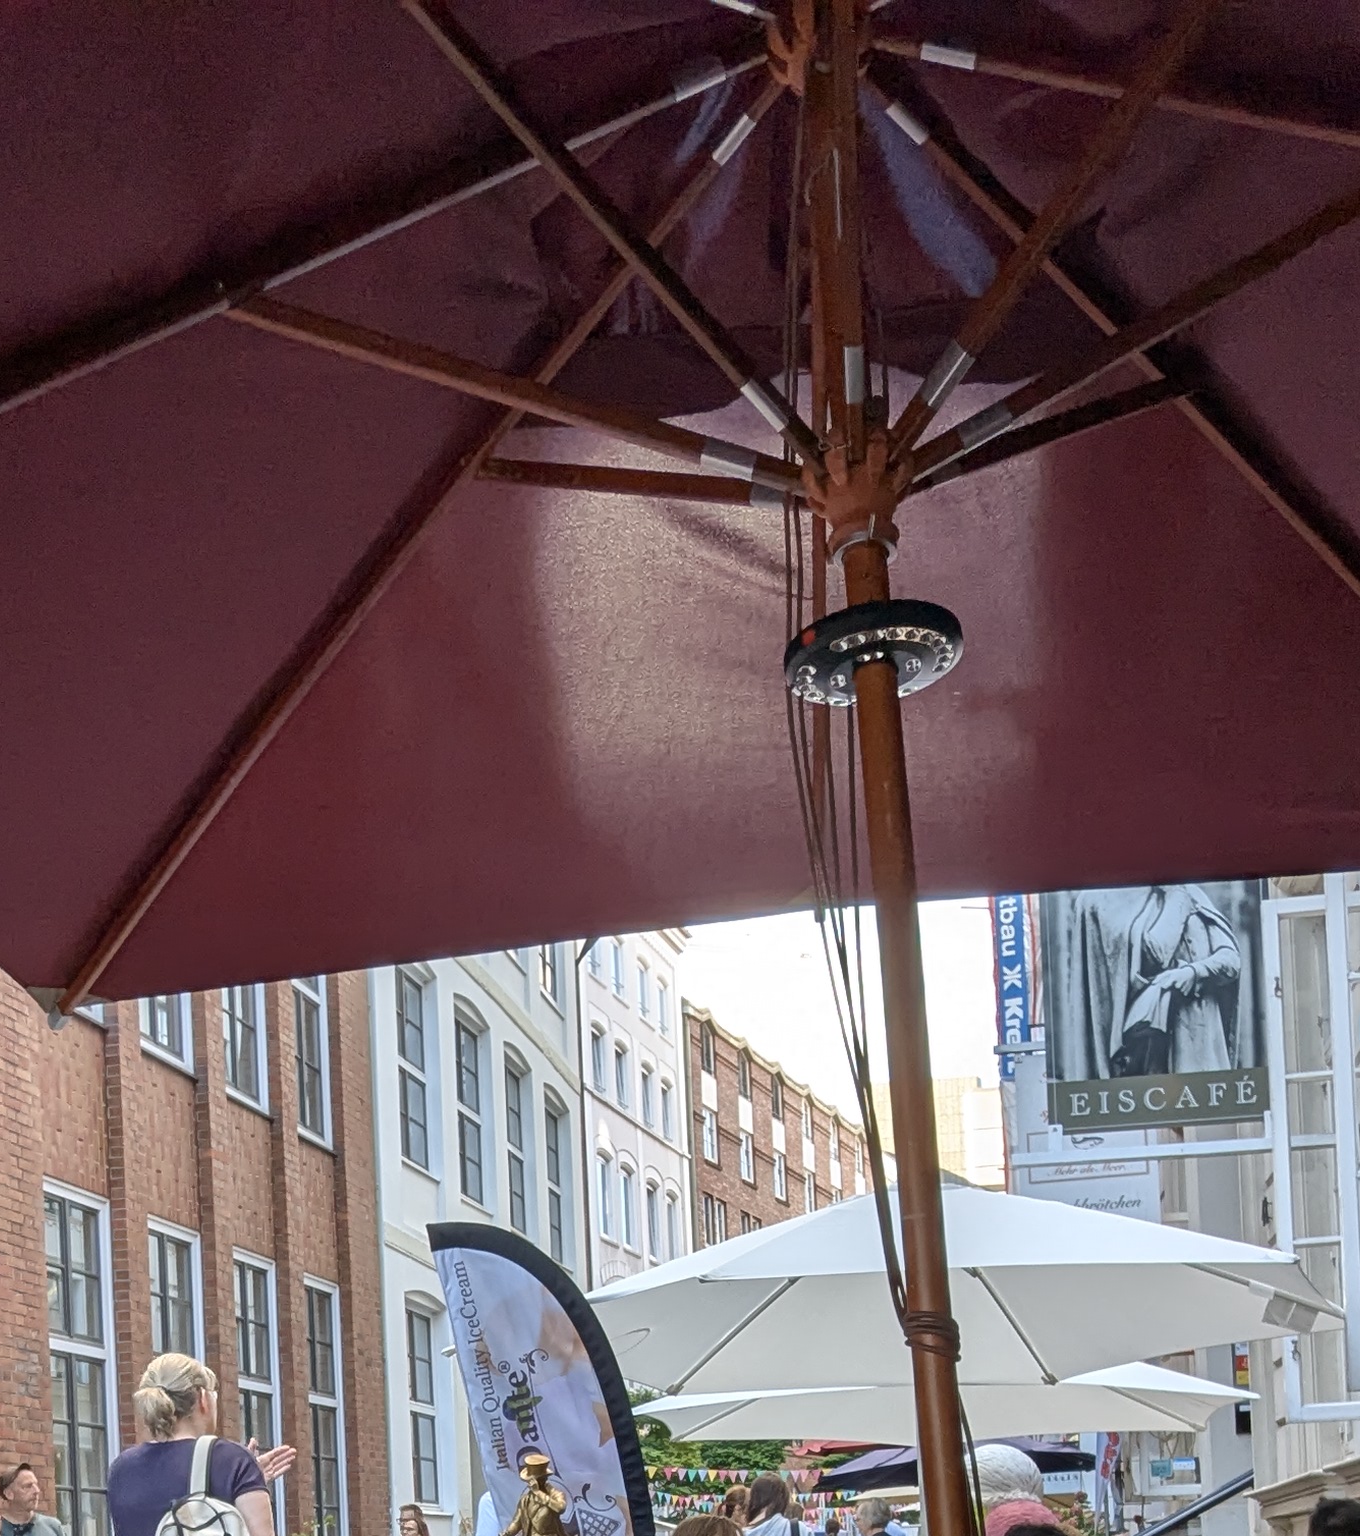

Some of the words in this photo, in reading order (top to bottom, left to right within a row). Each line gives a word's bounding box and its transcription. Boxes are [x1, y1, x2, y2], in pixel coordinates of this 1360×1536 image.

[1069, 1075, 1258, 1117] EISCAFÉ
[473, 1350, 501, 1413] Quality
[490, 1416, 510, 1471] Italian
